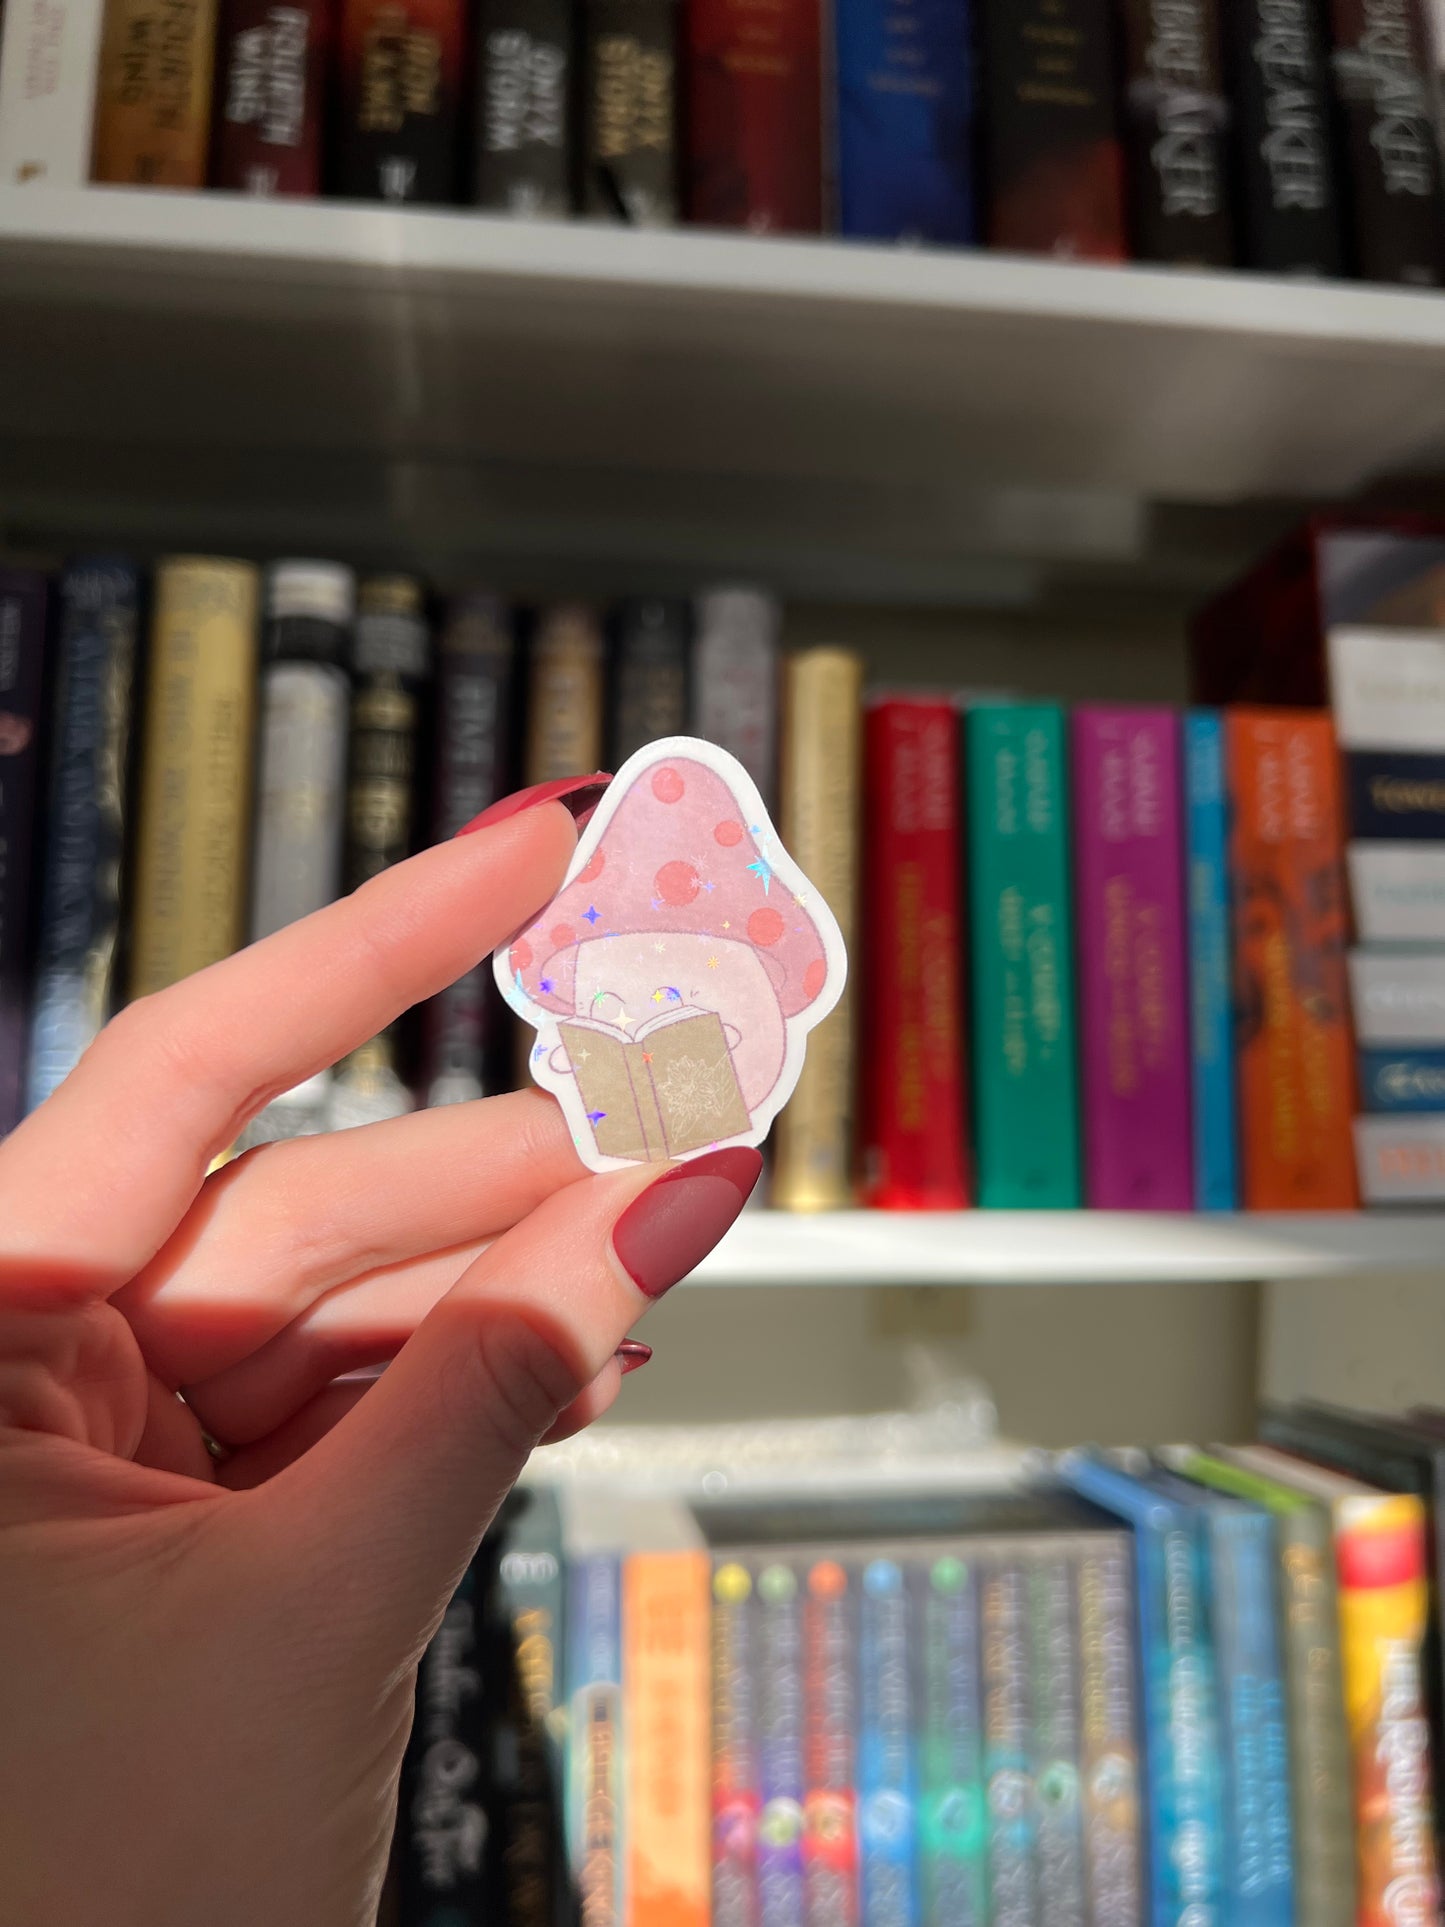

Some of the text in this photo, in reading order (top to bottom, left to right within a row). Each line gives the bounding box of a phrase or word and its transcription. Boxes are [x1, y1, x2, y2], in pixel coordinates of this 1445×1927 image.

[226, 26, 270, 124] WING
[258, 6, 310, 147] FOURTH
[486, 29, 532, 151] STORM
[525, 42, 566, 148] ONYX
[597, 36, 641, 156] STORM
[634, 48, 673, 152] ONYX
